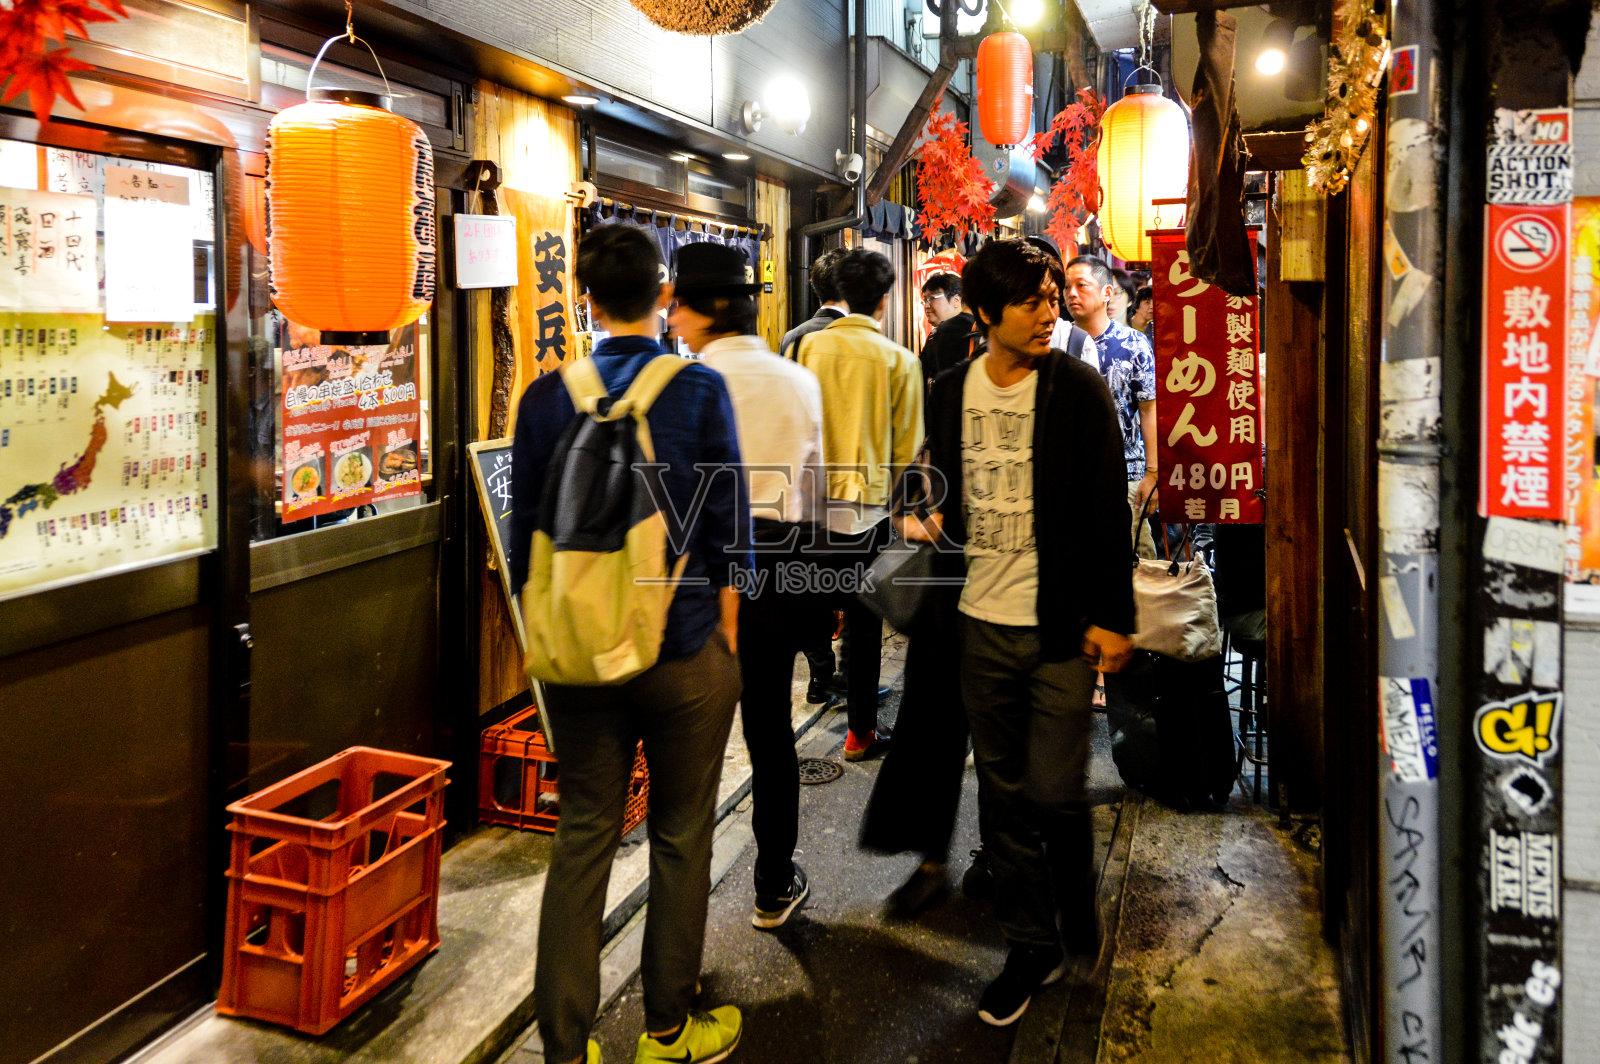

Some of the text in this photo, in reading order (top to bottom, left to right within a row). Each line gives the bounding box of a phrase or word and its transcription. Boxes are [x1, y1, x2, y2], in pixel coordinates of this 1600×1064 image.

[1491, 155, 1571, 171] ACTION
[534, 231, 567, 376] 安兵
[1165, 249, 1219, 447] らーめん
[286, 370, 393, 408] 自慢の串焼盛り合わせ
[383, 383, 416, 404] 800円
[1501, 285, 1551, 508] 敷地内禁煙
[1168, 461, 1254, 491] 480円
[1184, 498, 1240, 520] 若月
[1419, 702, 1437, 758] HELLO
[1480, 702, 1554, 757] G!
[1496, 834, 1521, 909] STAR!
